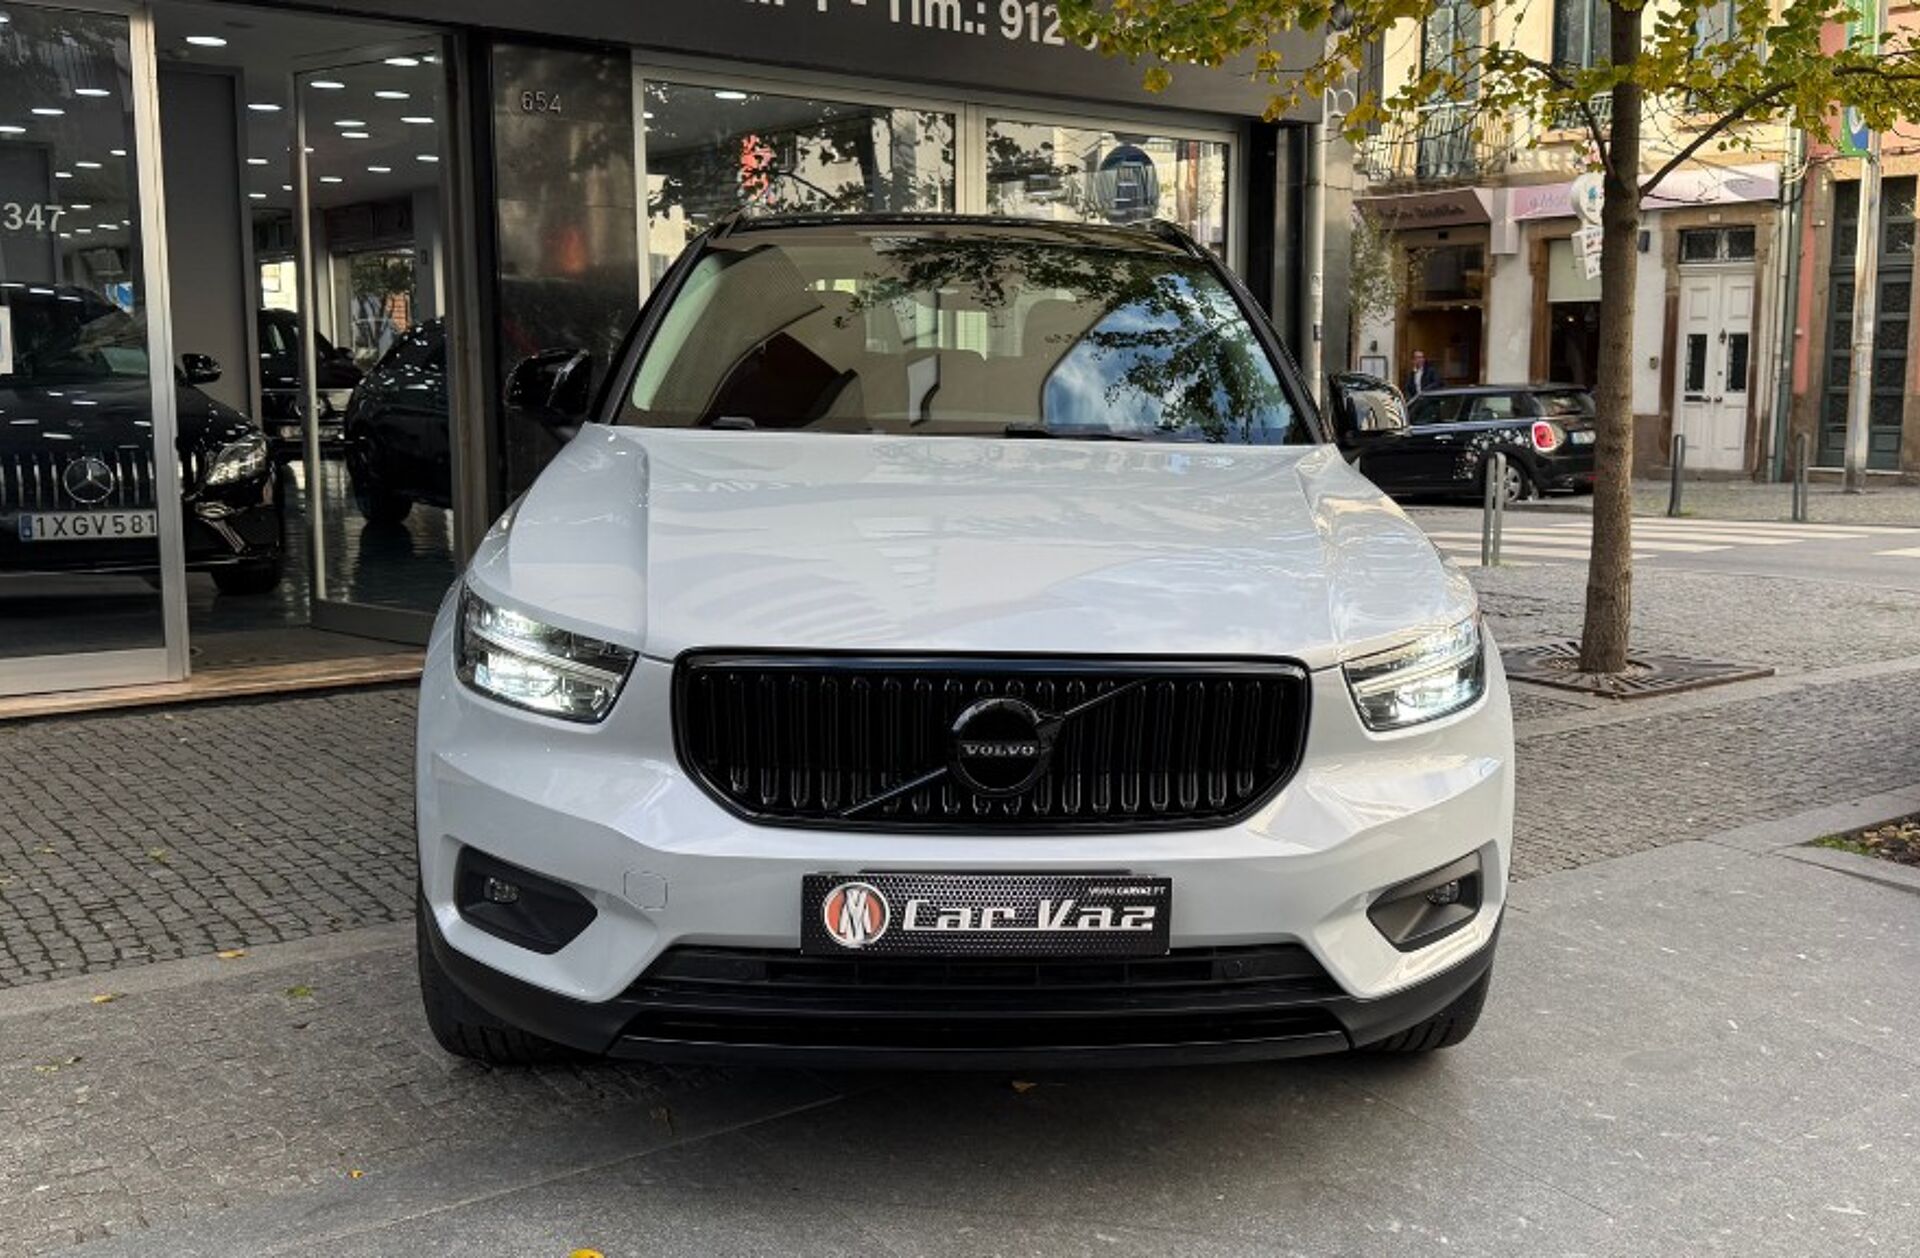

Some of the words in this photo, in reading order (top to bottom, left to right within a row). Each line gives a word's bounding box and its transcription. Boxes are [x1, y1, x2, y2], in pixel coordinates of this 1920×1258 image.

[521, 91, 561, 113] 654
[3, 202, 64, 232] 347
[963, 745, 1035, 756] VOLVO
[903, 899, 1016, 932] Car
[1038, 899, 1156, 932] Vaz
